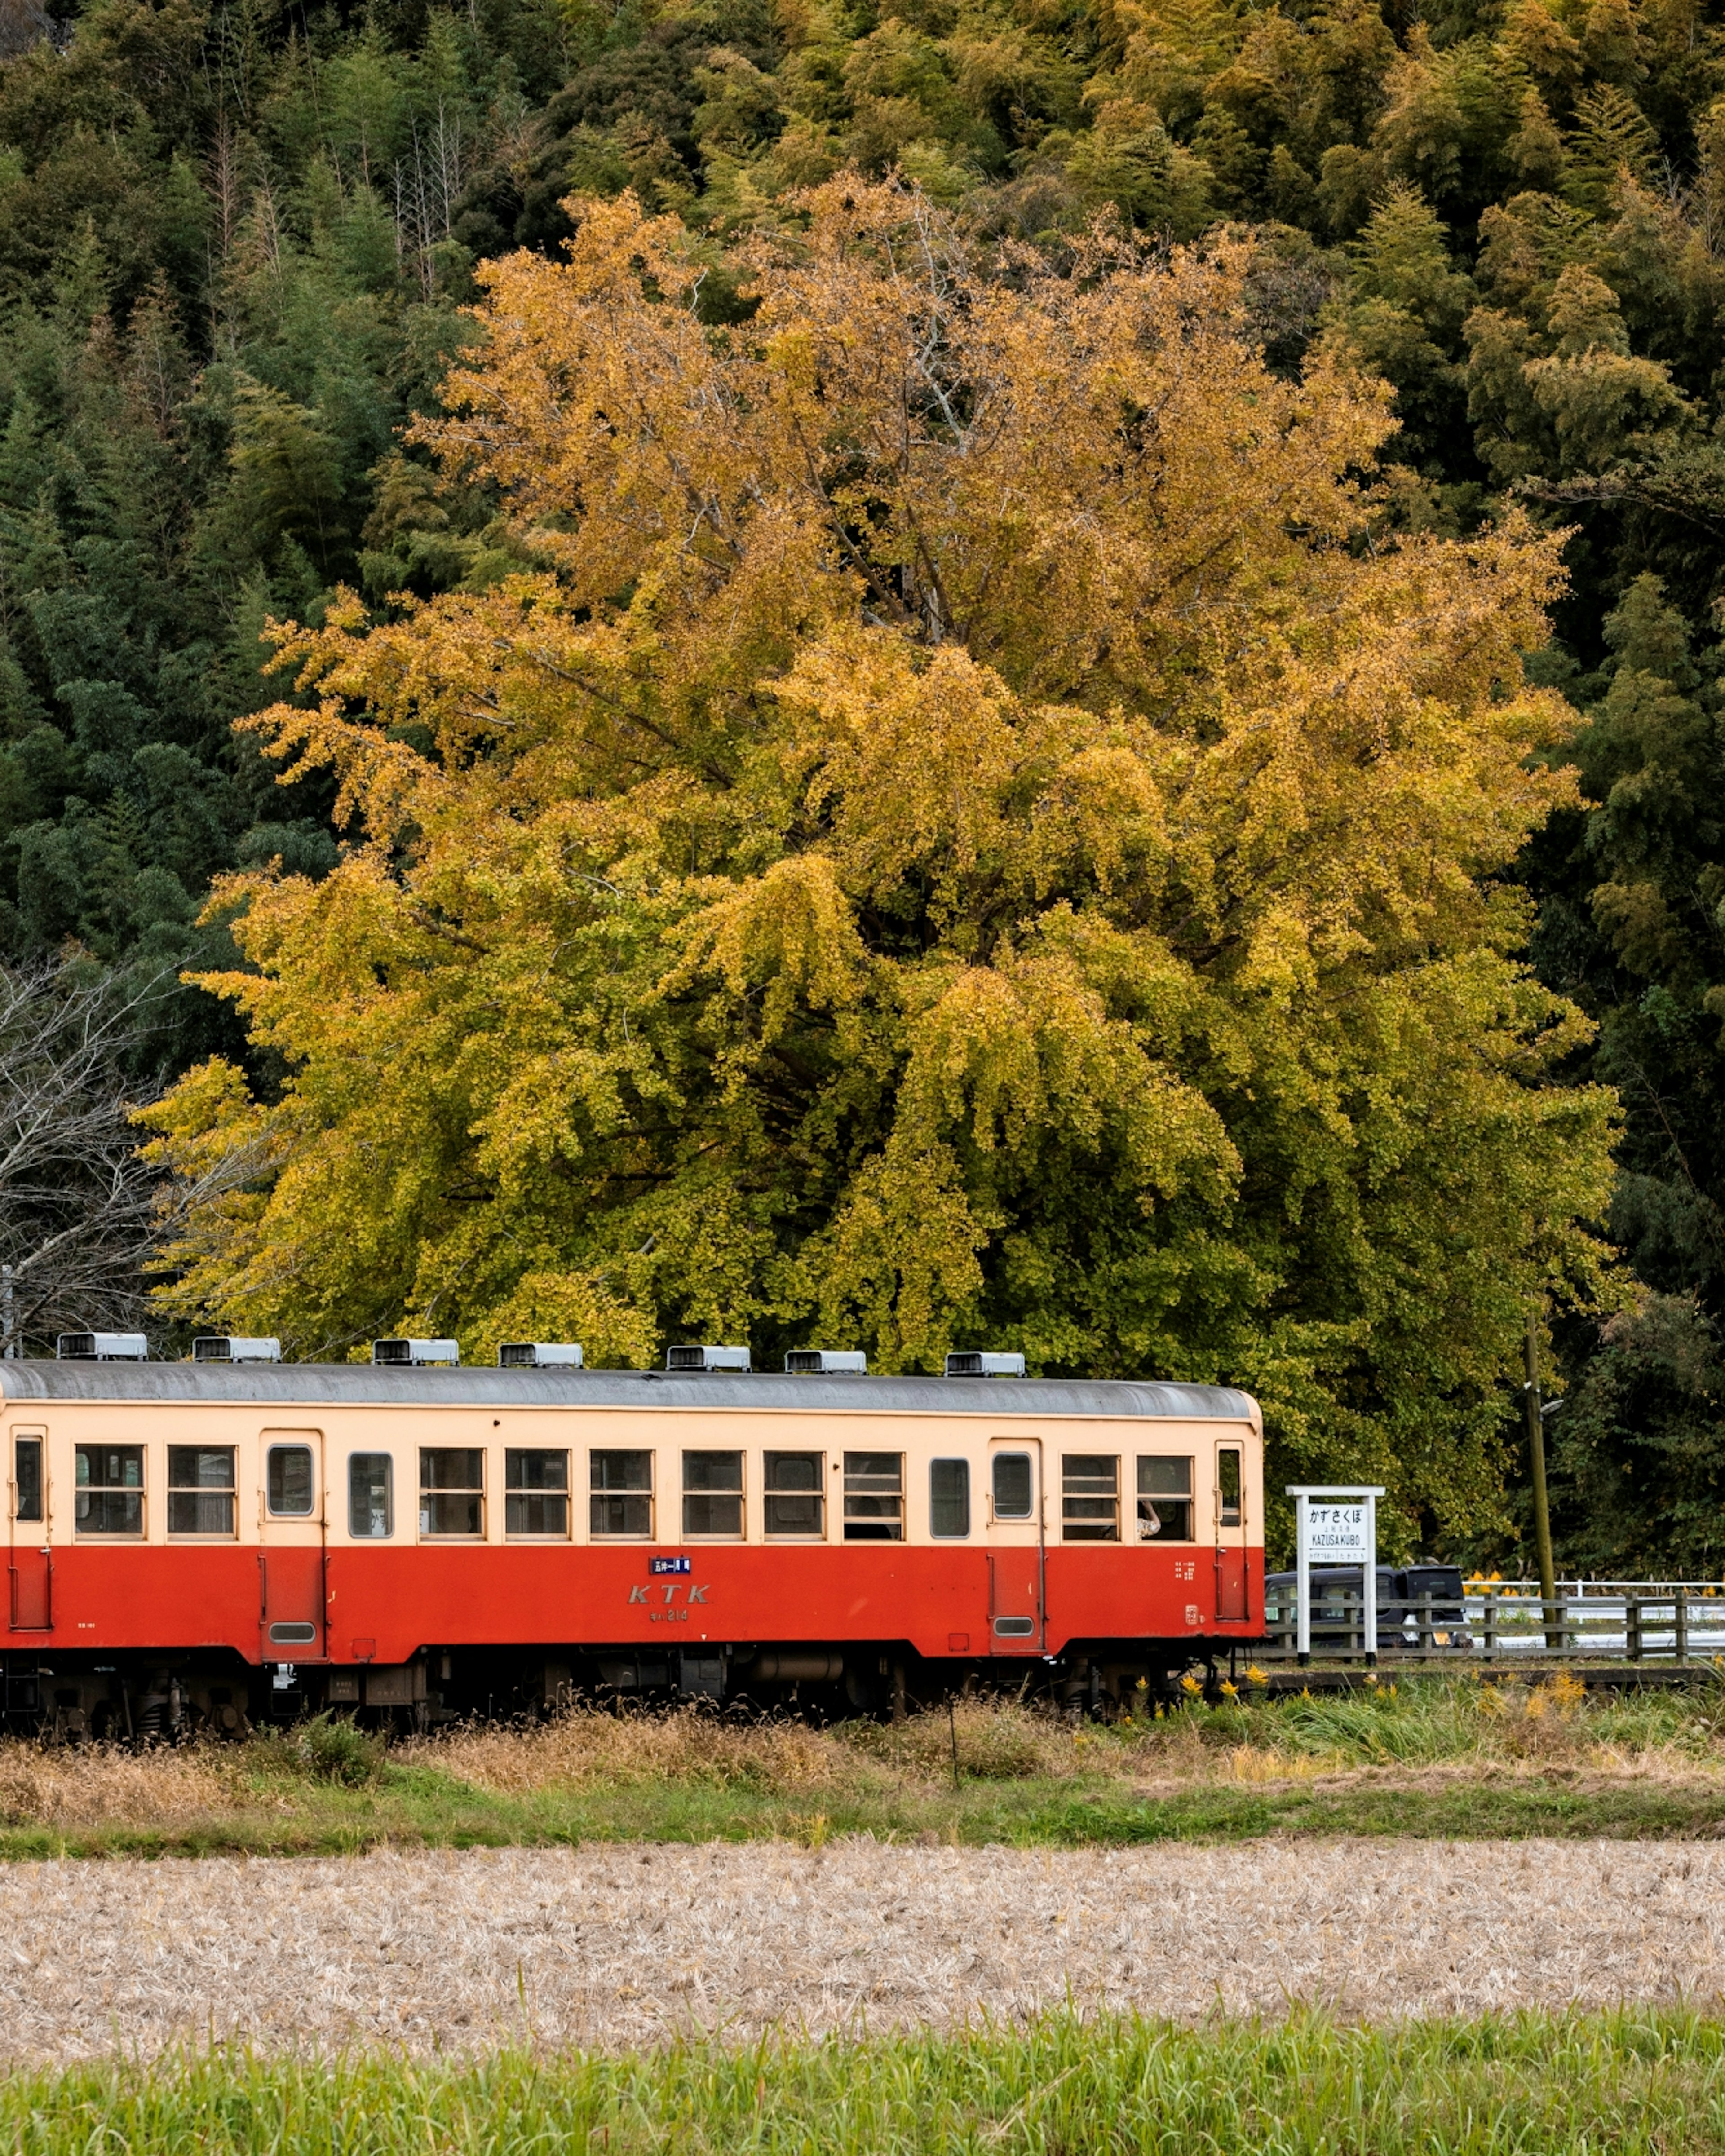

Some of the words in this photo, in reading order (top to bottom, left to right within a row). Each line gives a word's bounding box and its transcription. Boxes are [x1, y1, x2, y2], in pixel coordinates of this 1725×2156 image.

[1309, 1509, 1363, 1523] かずさくぼ
